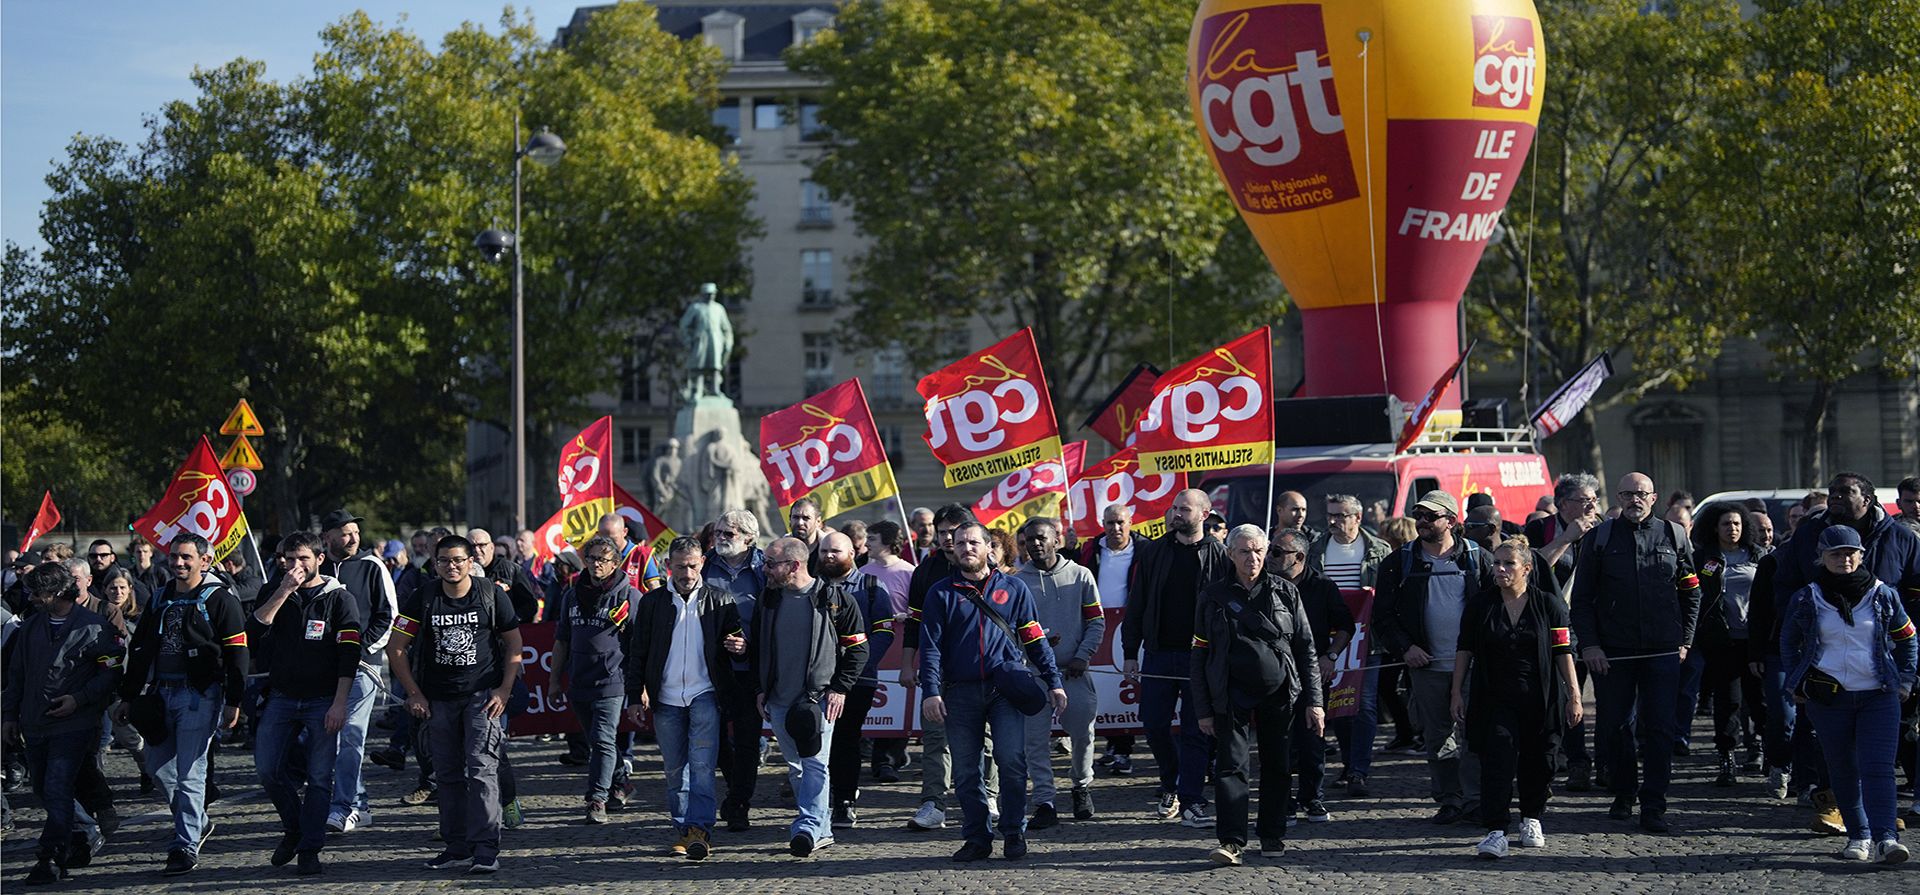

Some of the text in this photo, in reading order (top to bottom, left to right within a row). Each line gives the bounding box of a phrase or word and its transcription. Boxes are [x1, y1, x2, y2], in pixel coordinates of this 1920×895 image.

[1200, 12, 1300, 81] la
[1479, 17, 1530, 56] la
[1473, 47, 1536, 108] cgt
[1201, 50, 1345, 167] cgt
[1474, 130, 1516, 160] ILE
[1278, 187, 1334, 208] France
[1460, 172, 1502, 200] DE
[1398, 207, 1503, 242] FRANC
[231, 475, 249, 487] 30
[431, 611, 479, 626] RISING
[1096, 711, 1141, 724] etrait
